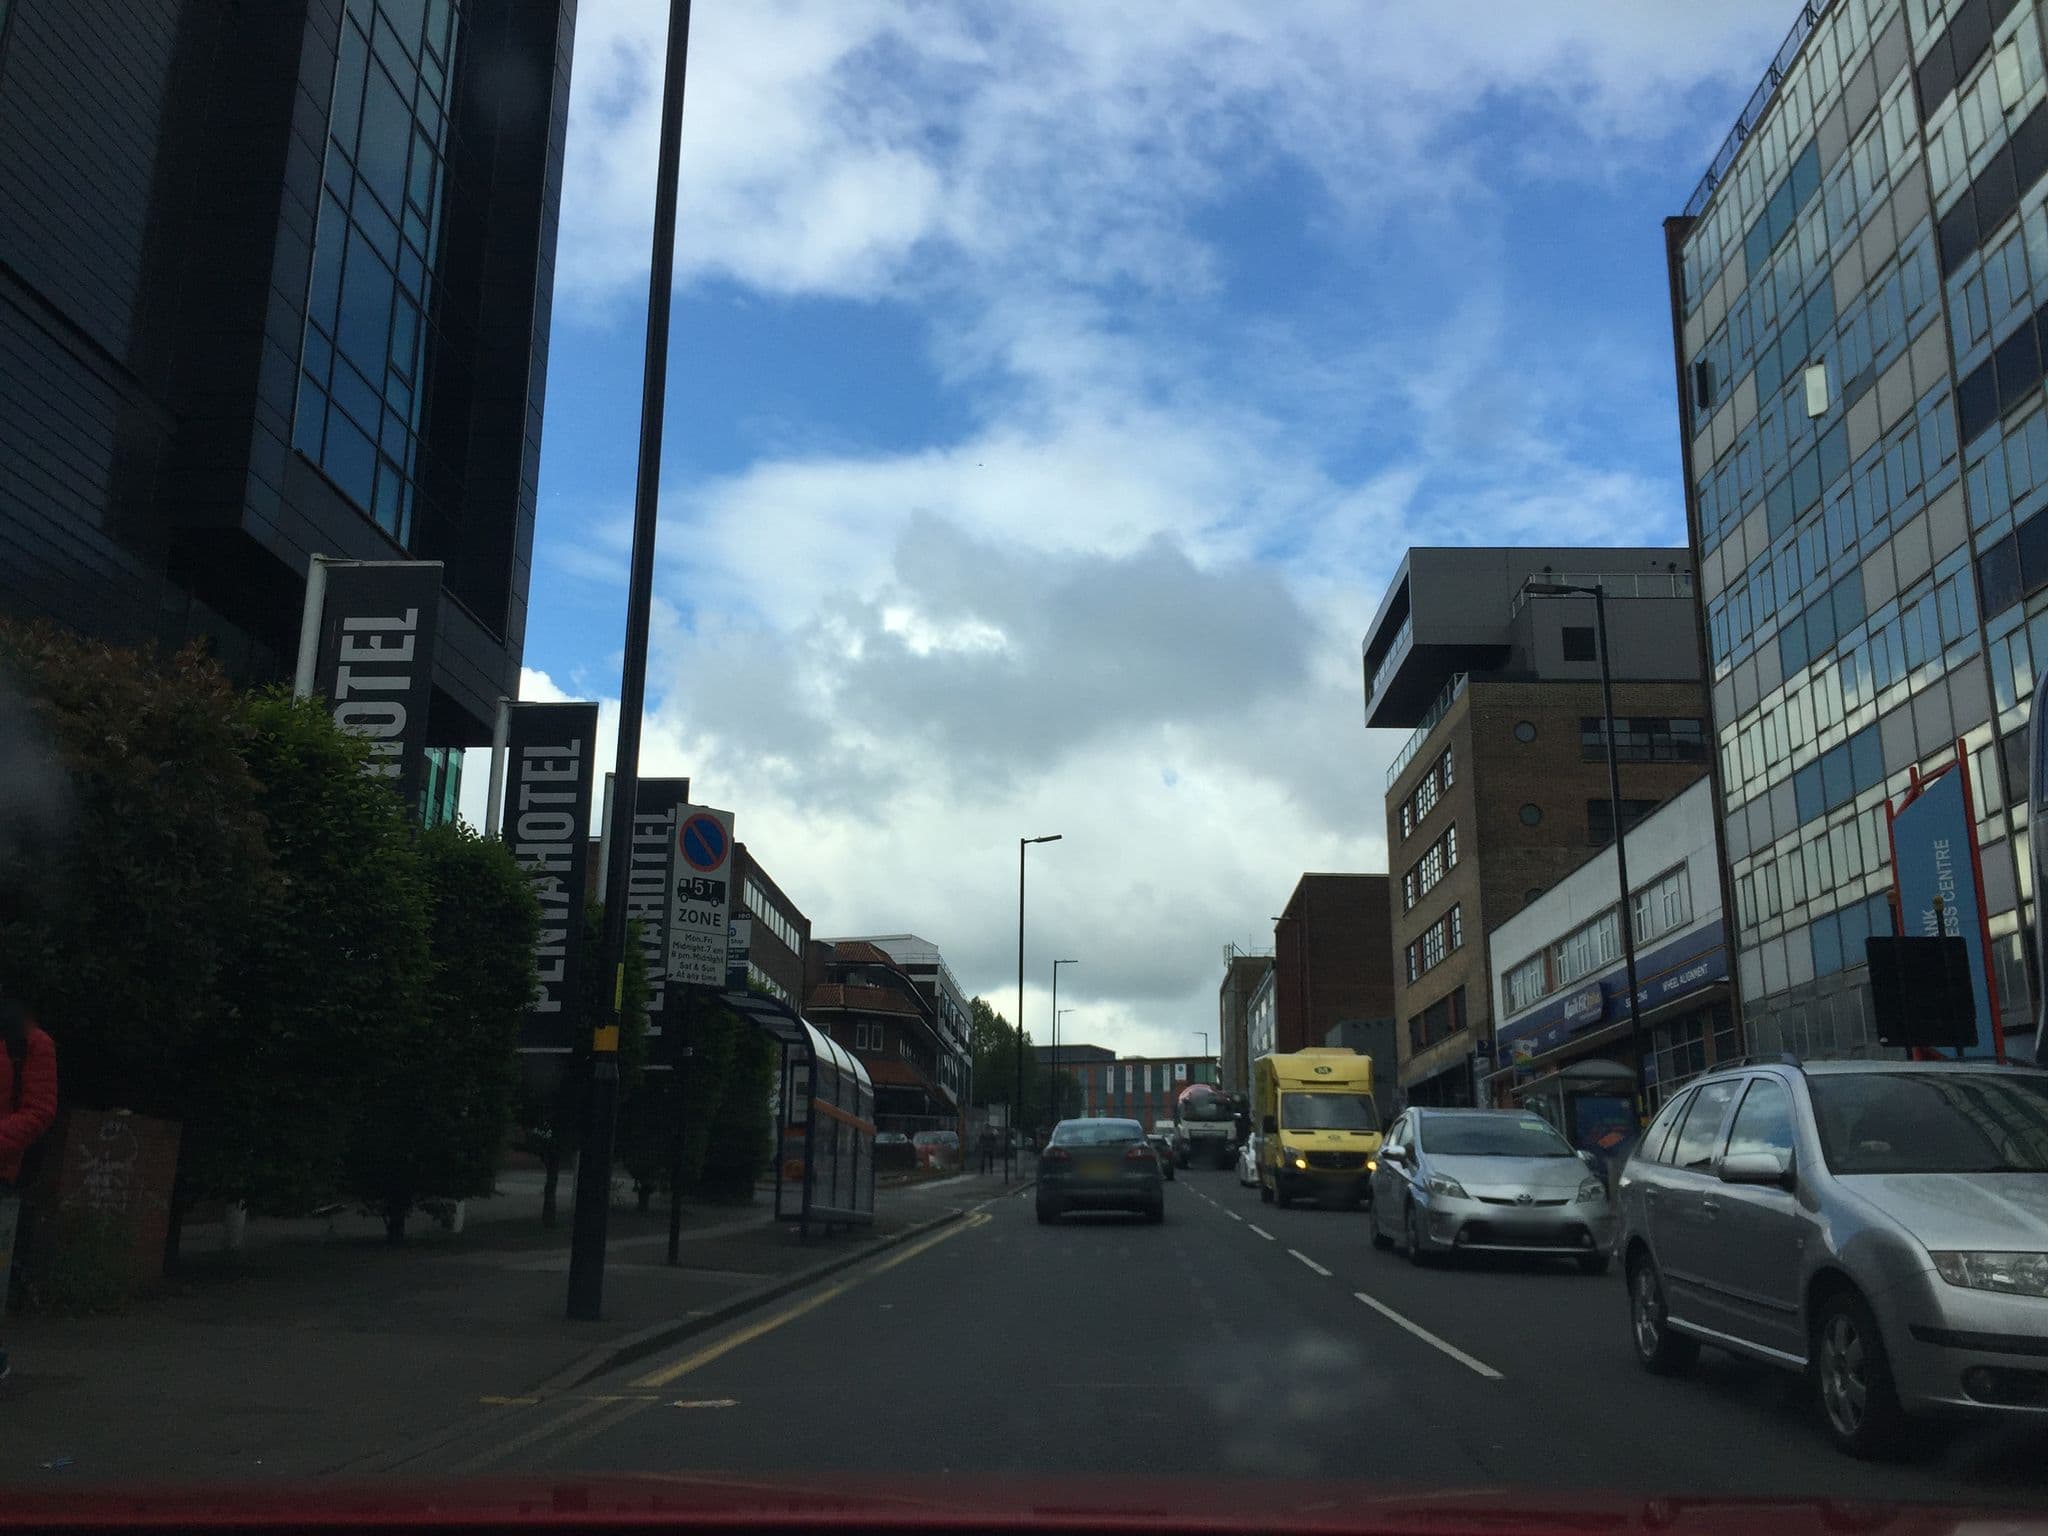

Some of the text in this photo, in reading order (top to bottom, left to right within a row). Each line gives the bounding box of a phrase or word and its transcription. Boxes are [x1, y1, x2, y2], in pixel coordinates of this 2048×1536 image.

[1934, 839, 1955, 902] CENTRE
[679, 908, 721, 927] ZONE
[680, 961, 692, 970] Sat
[702, 964, 716, 972] Sun
[1662, 963, 1708, 993] WHEEL ALIGNMENT
